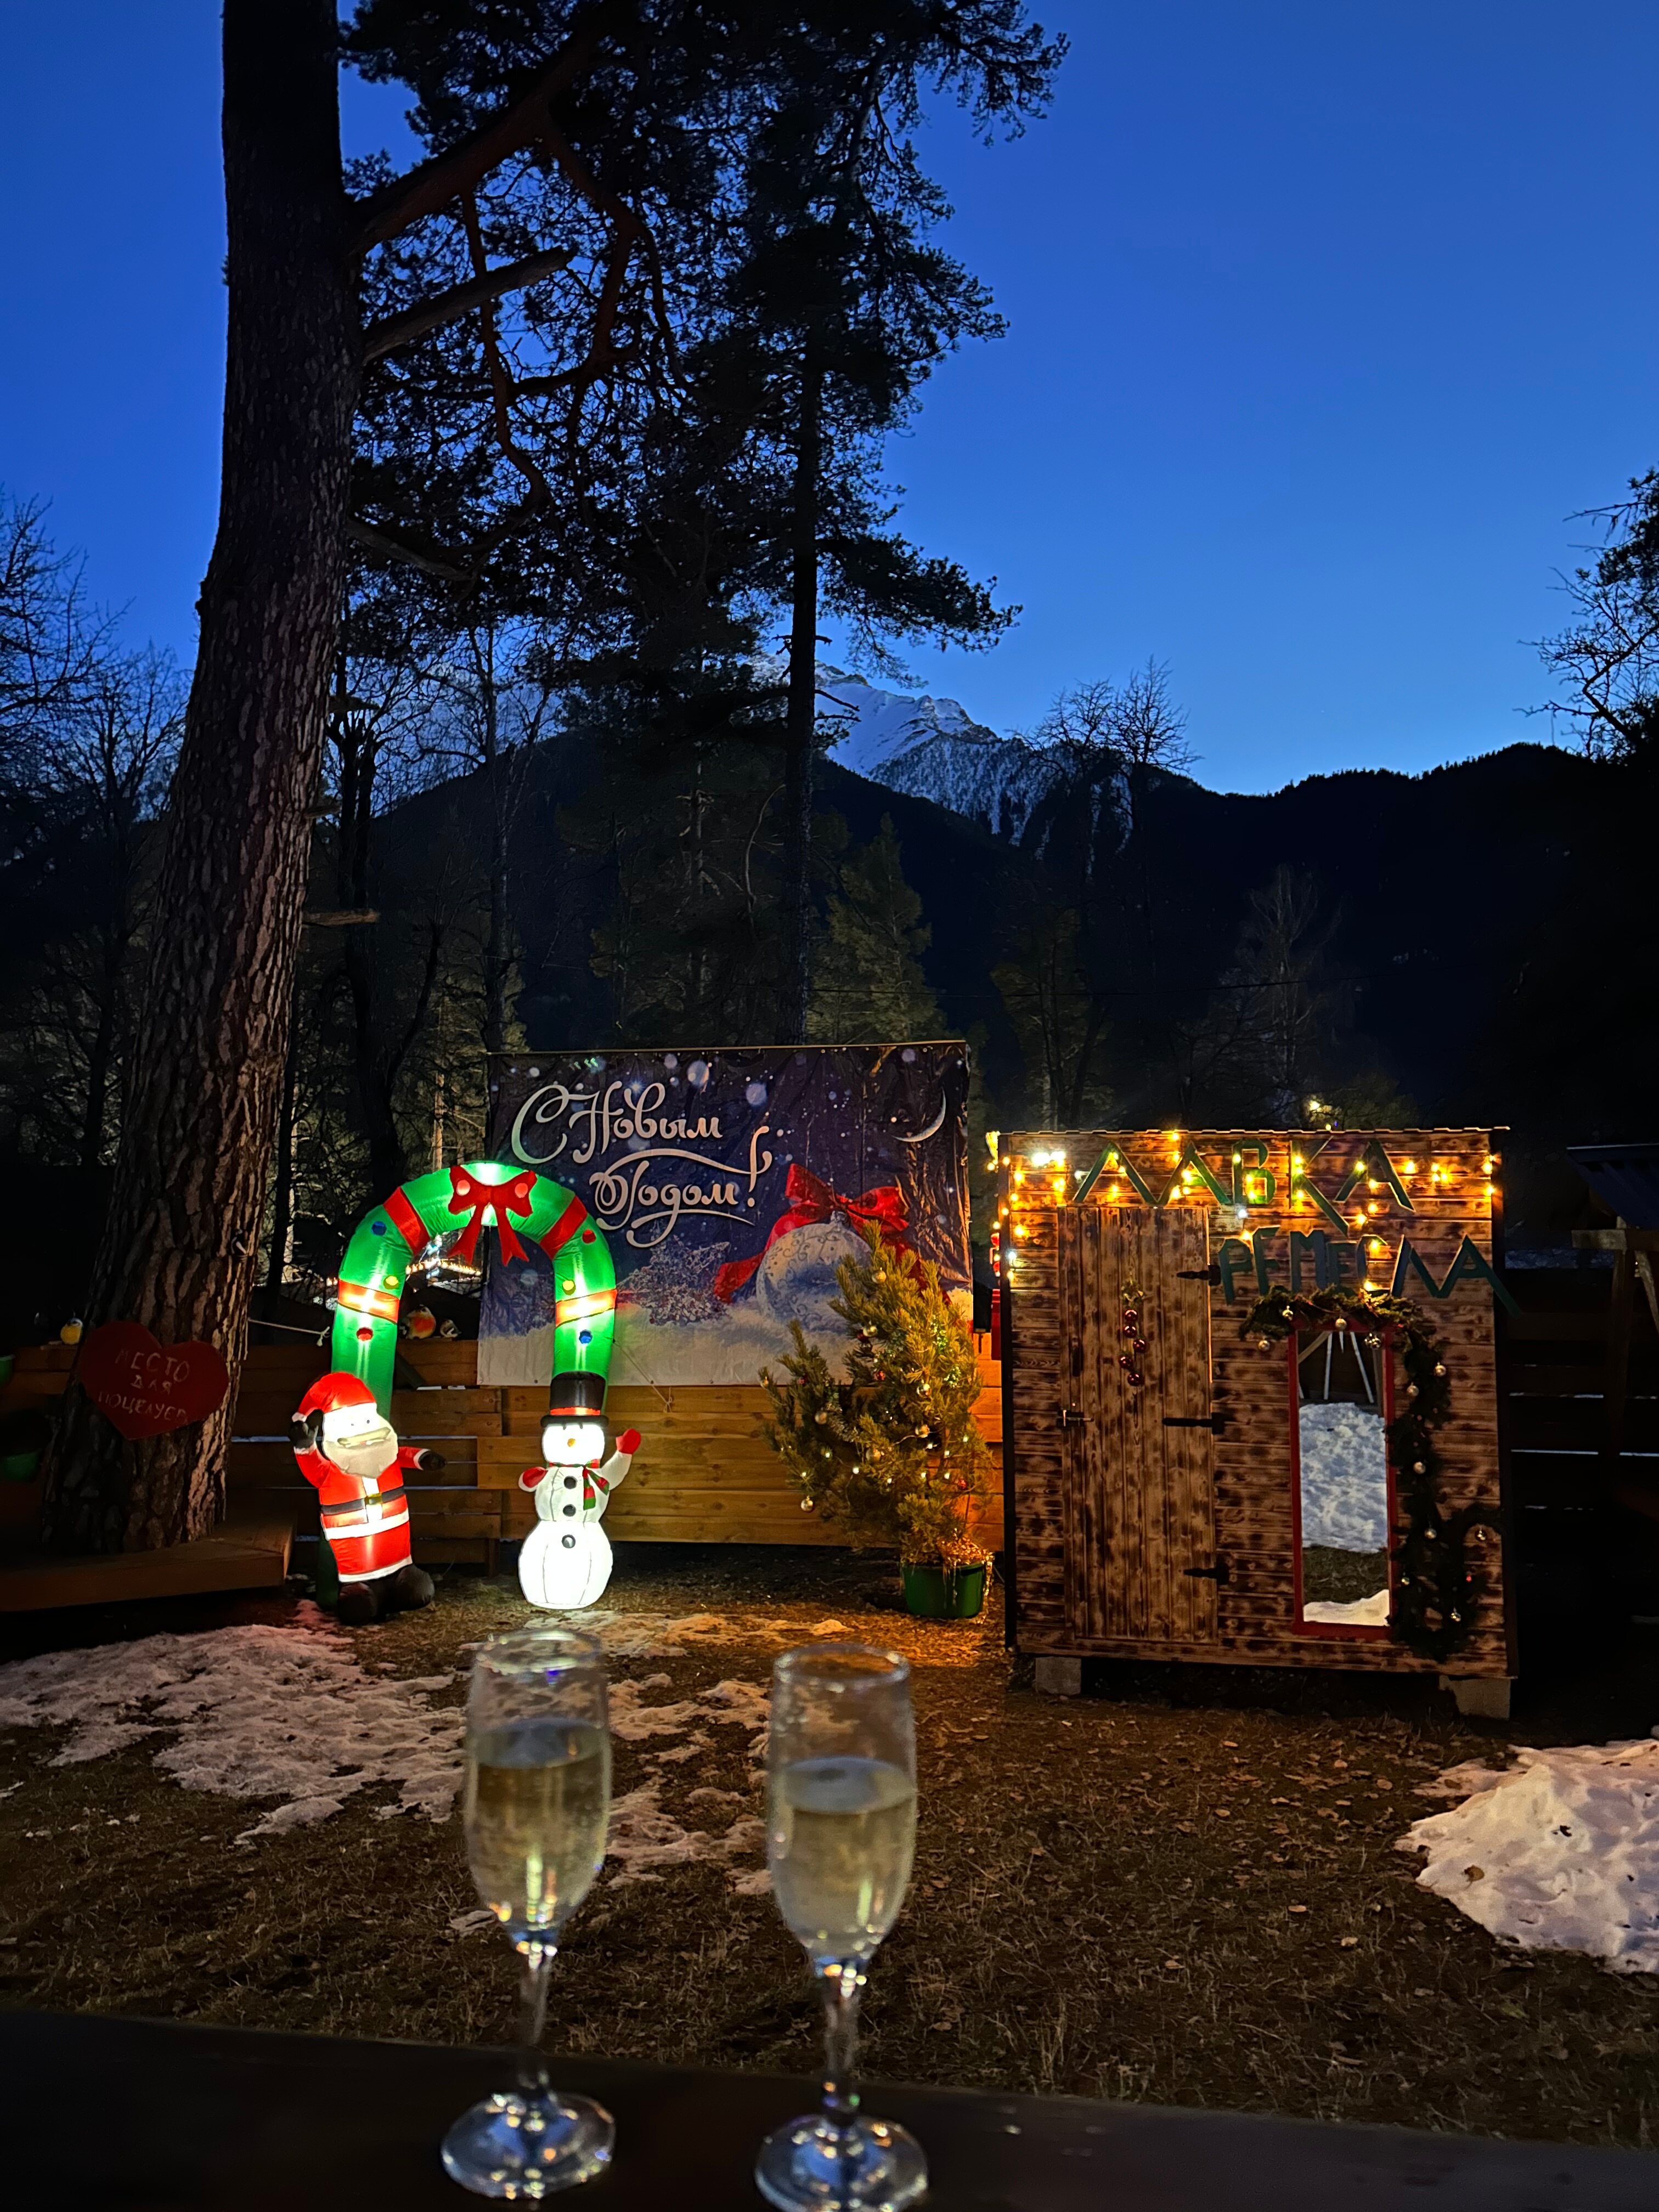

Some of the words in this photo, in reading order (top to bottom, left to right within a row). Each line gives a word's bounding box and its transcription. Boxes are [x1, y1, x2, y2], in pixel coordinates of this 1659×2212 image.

[511, 1083, 569, 1164] С
[569, 1080, 724, 1164] Новым
[589, 1126, 772, 1248] Годом!
[1073, 1136, 1415, 1237] ЛАВКА
[1217, 1225, 1523, 1317] РЕМЕСЛА
[98, 1391, 188, 1424] ПОЦЕЛУЕВ
[115, 1348, 190, 1383] МЕСТО
[130, 1374, 173, 1395] ДЛЯ
